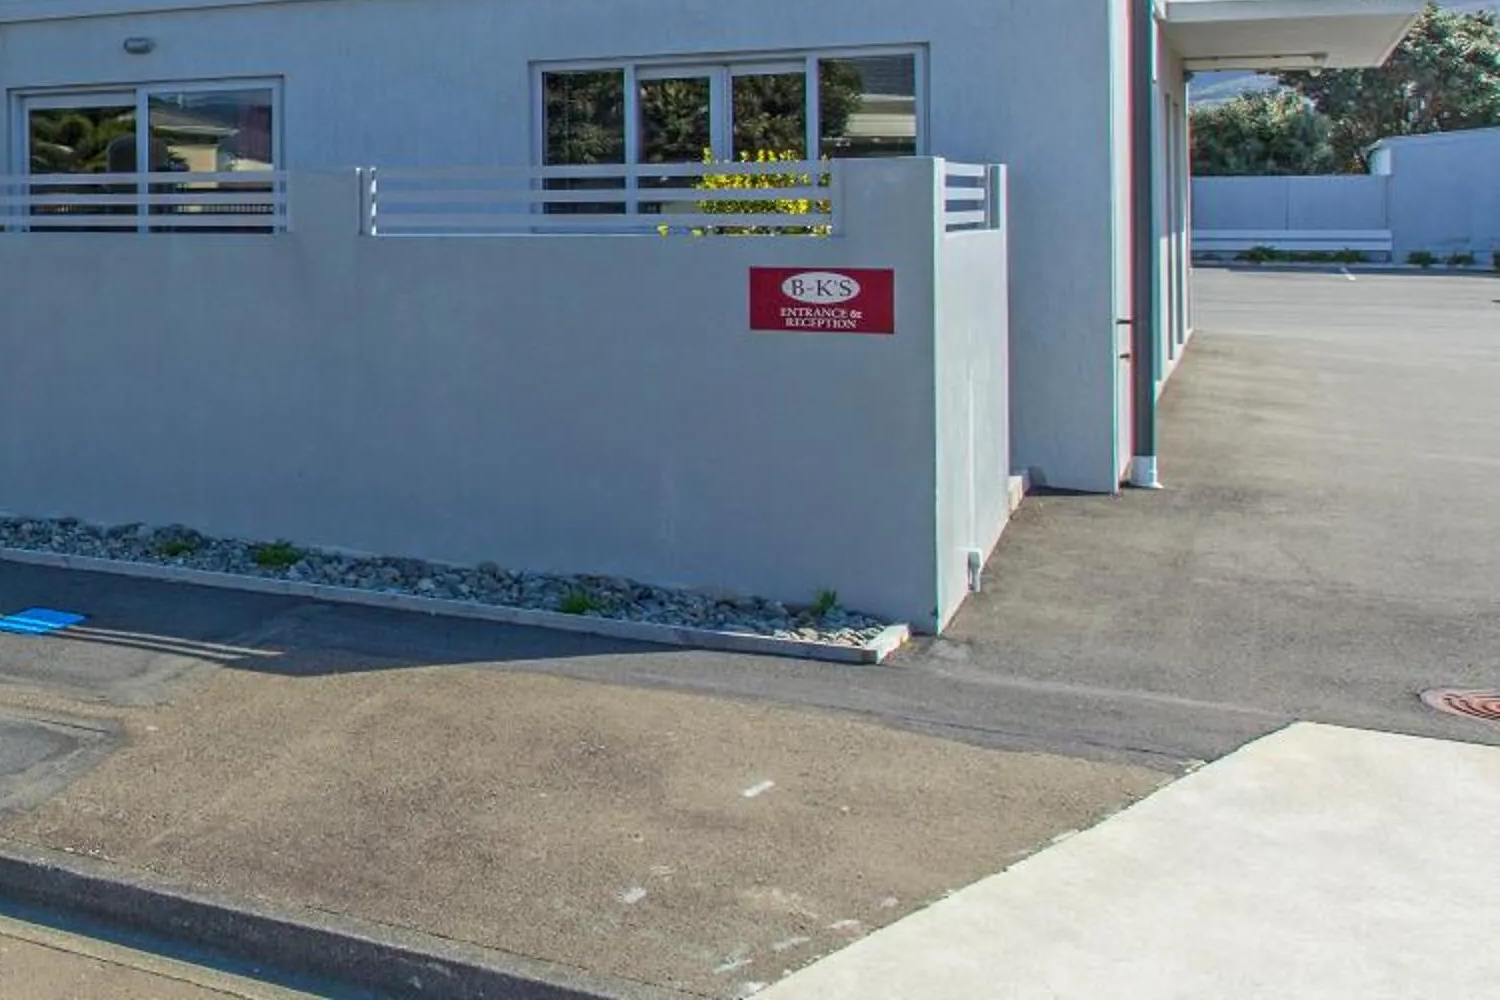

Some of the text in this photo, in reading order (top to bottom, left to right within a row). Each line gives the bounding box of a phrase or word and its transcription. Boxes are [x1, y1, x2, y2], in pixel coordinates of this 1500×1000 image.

[780, 307, 863, 319] ENTRANCE &
[785, 317, 857, 329] RECEPTION
